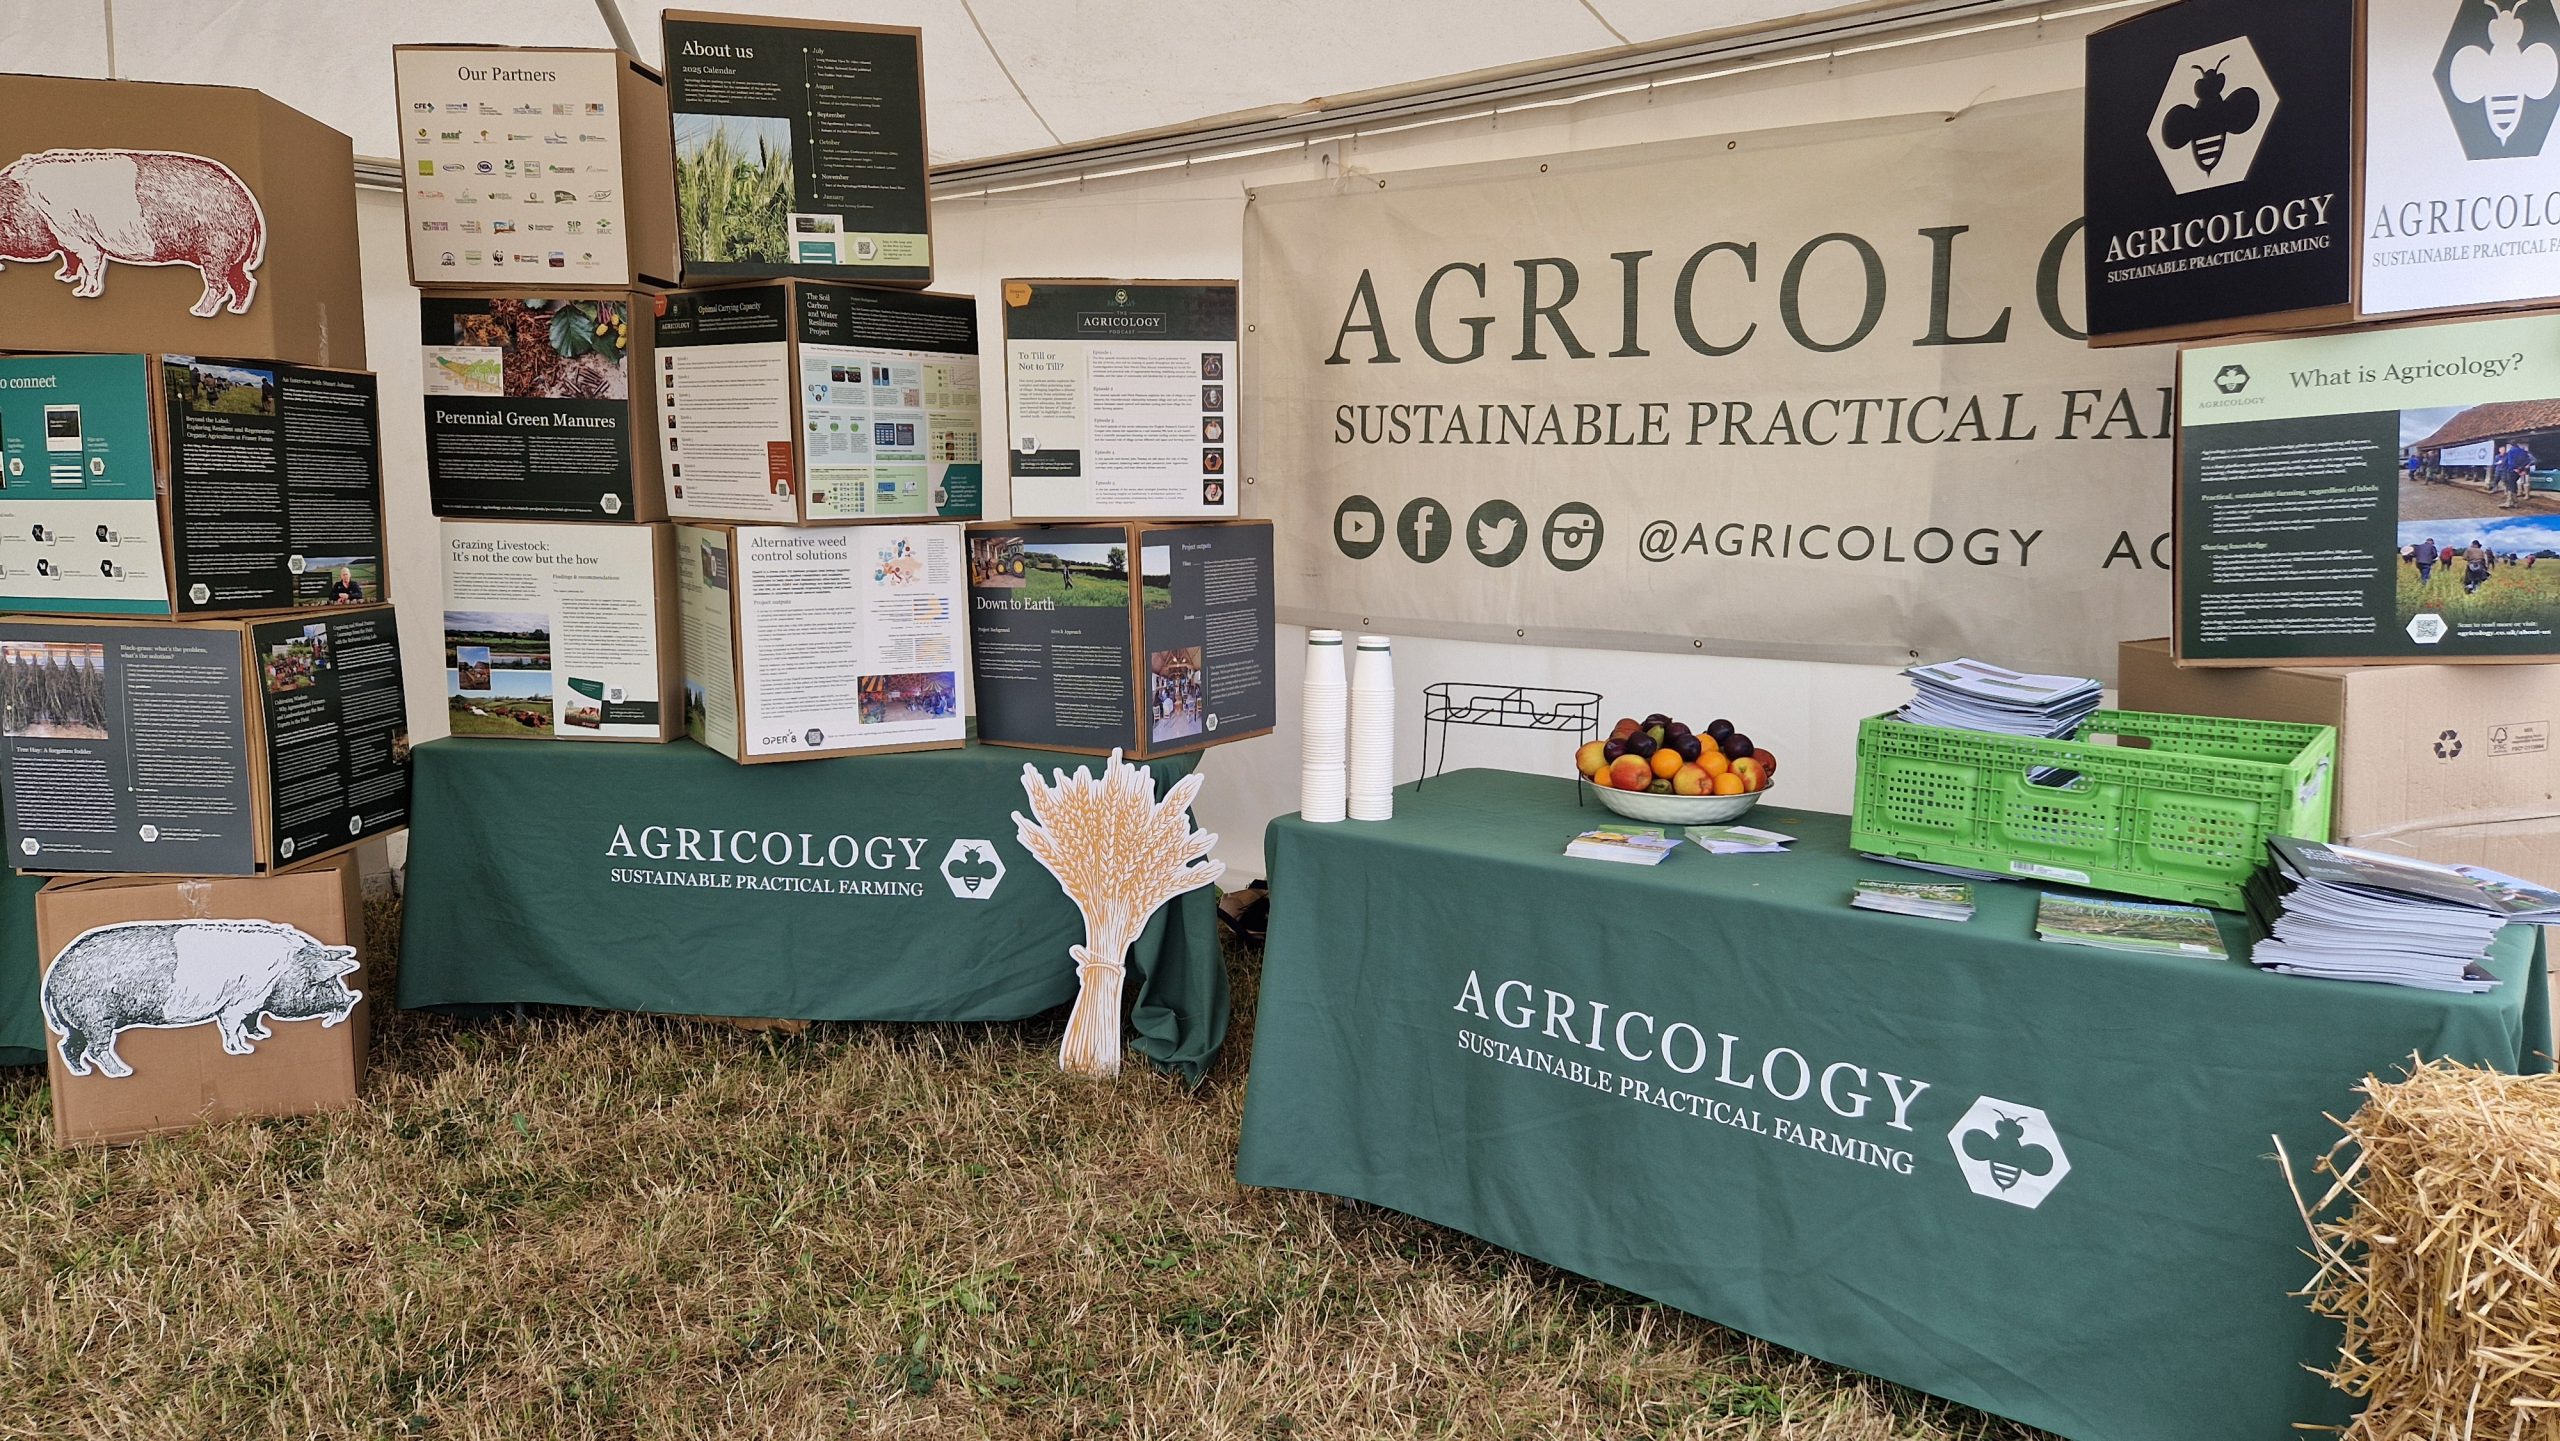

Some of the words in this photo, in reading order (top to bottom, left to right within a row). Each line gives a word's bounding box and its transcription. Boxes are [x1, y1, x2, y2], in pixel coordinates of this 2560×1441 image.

[682, 41, 731, 57] About
[735, 47, 754, 58] us
[458, 66, 488, 81] Our
[492, 67, 556, 82] Partners
[682, 66, 702, 74] 2025
[703, 66, 736, 75] Calendar
[2105, 193, 2334, 262] AGRICOLOGY
[2107, 256, 2188, 283] SUSTAINABLE
[2189, 246, 2260, 269] PRACTICAL
[2263, 234, 2330, 258] FARMING
[2372, 245, 2470, 268] SUSTAINABLE
[2473, 239, 2547, 259] PRACTICAL
[698, 305, 717, 315] Optimal
[718, 304, 739, 313] Carrying
[740, 302, 761, 312] Capacity
[807, 302, 828, 310] Carbon
[662, 322, 690, 330] AGRICOLOGY
[809, 319, 838, 327] Resilience
[1084, 318, 1160, 327] AGRICOLOGY
[809, 328, 830, 336] Project
[1030, 352, 1045, 360] Till
[1018, 362, 1032, 370] Not
[1045, 362, 1064, 371] Till?
[2290, 368, 2350, 388] What
[2358, 366, 2376, 384] is
[2382, 352, 2524, 385] Agricology?
[10, 375, 57, 389] connect
[2199, 397, 2266, 408] AGRICOLOGY
[186, 416, 205, 424] Beyond
[436, 410, 502, 425] Perennial
[506, 412, 550, 426] Green
[553, 413, 616, 428] Manures
[1334, 400, 1669, 446] SUSTAINABLE
[1684, 391, 2037, 446] PRACTICAL
[187, 424, 211, 432] Exploring
[245, 427, 275, 435] Regenerative
[2202, 494, 2234, 502] Practical,
[2234, 491, 2275, 499] sustainable
[2276, 490, 2307, 498] farming,
[2308, 487, 2346, 496] regardless
[452, 539, 494, 552] Grazing
[497, 540, 550, 551] Livestock:
[751, 536, 812, 548] Alternative
[814, 537, 846, 547] weed
[1638, 519, 2044, 568] @AGRICOLOGY
[453, 552, 469, 562] It's
[472, 554, 490, 563] not
[492, 552, 509, 563] the
[536, 553, 553, 564] but
[557, 554, 573, 564] the
[576, 554, 599, 565] how
[751, 551, 793, 562] control
[795, 549, 848, 560] solutions
[977, 596, 1008, 610] Down
[1011, 598, 1021, 610] to
[1024, 597, 1055, 610] Earth
[120, 644, 154, 652] Black-grass:
[606, 824, 929, 870] AGRICOLOGY
[610, 868, 732, 888] SUSTAINABLE
[735, 874, 835, 894] PRACTICAL
[839, 880, 924, 897] FARMING
[1453, 969, 1930, 1131] AGRICOLOGY
[1457, 1028, 1613, 1093] SUSTAINABLE
[1618, 1075, 1767, 1135] PRACTICAL
[1772, 1116, 1914, 1175] FARMING
